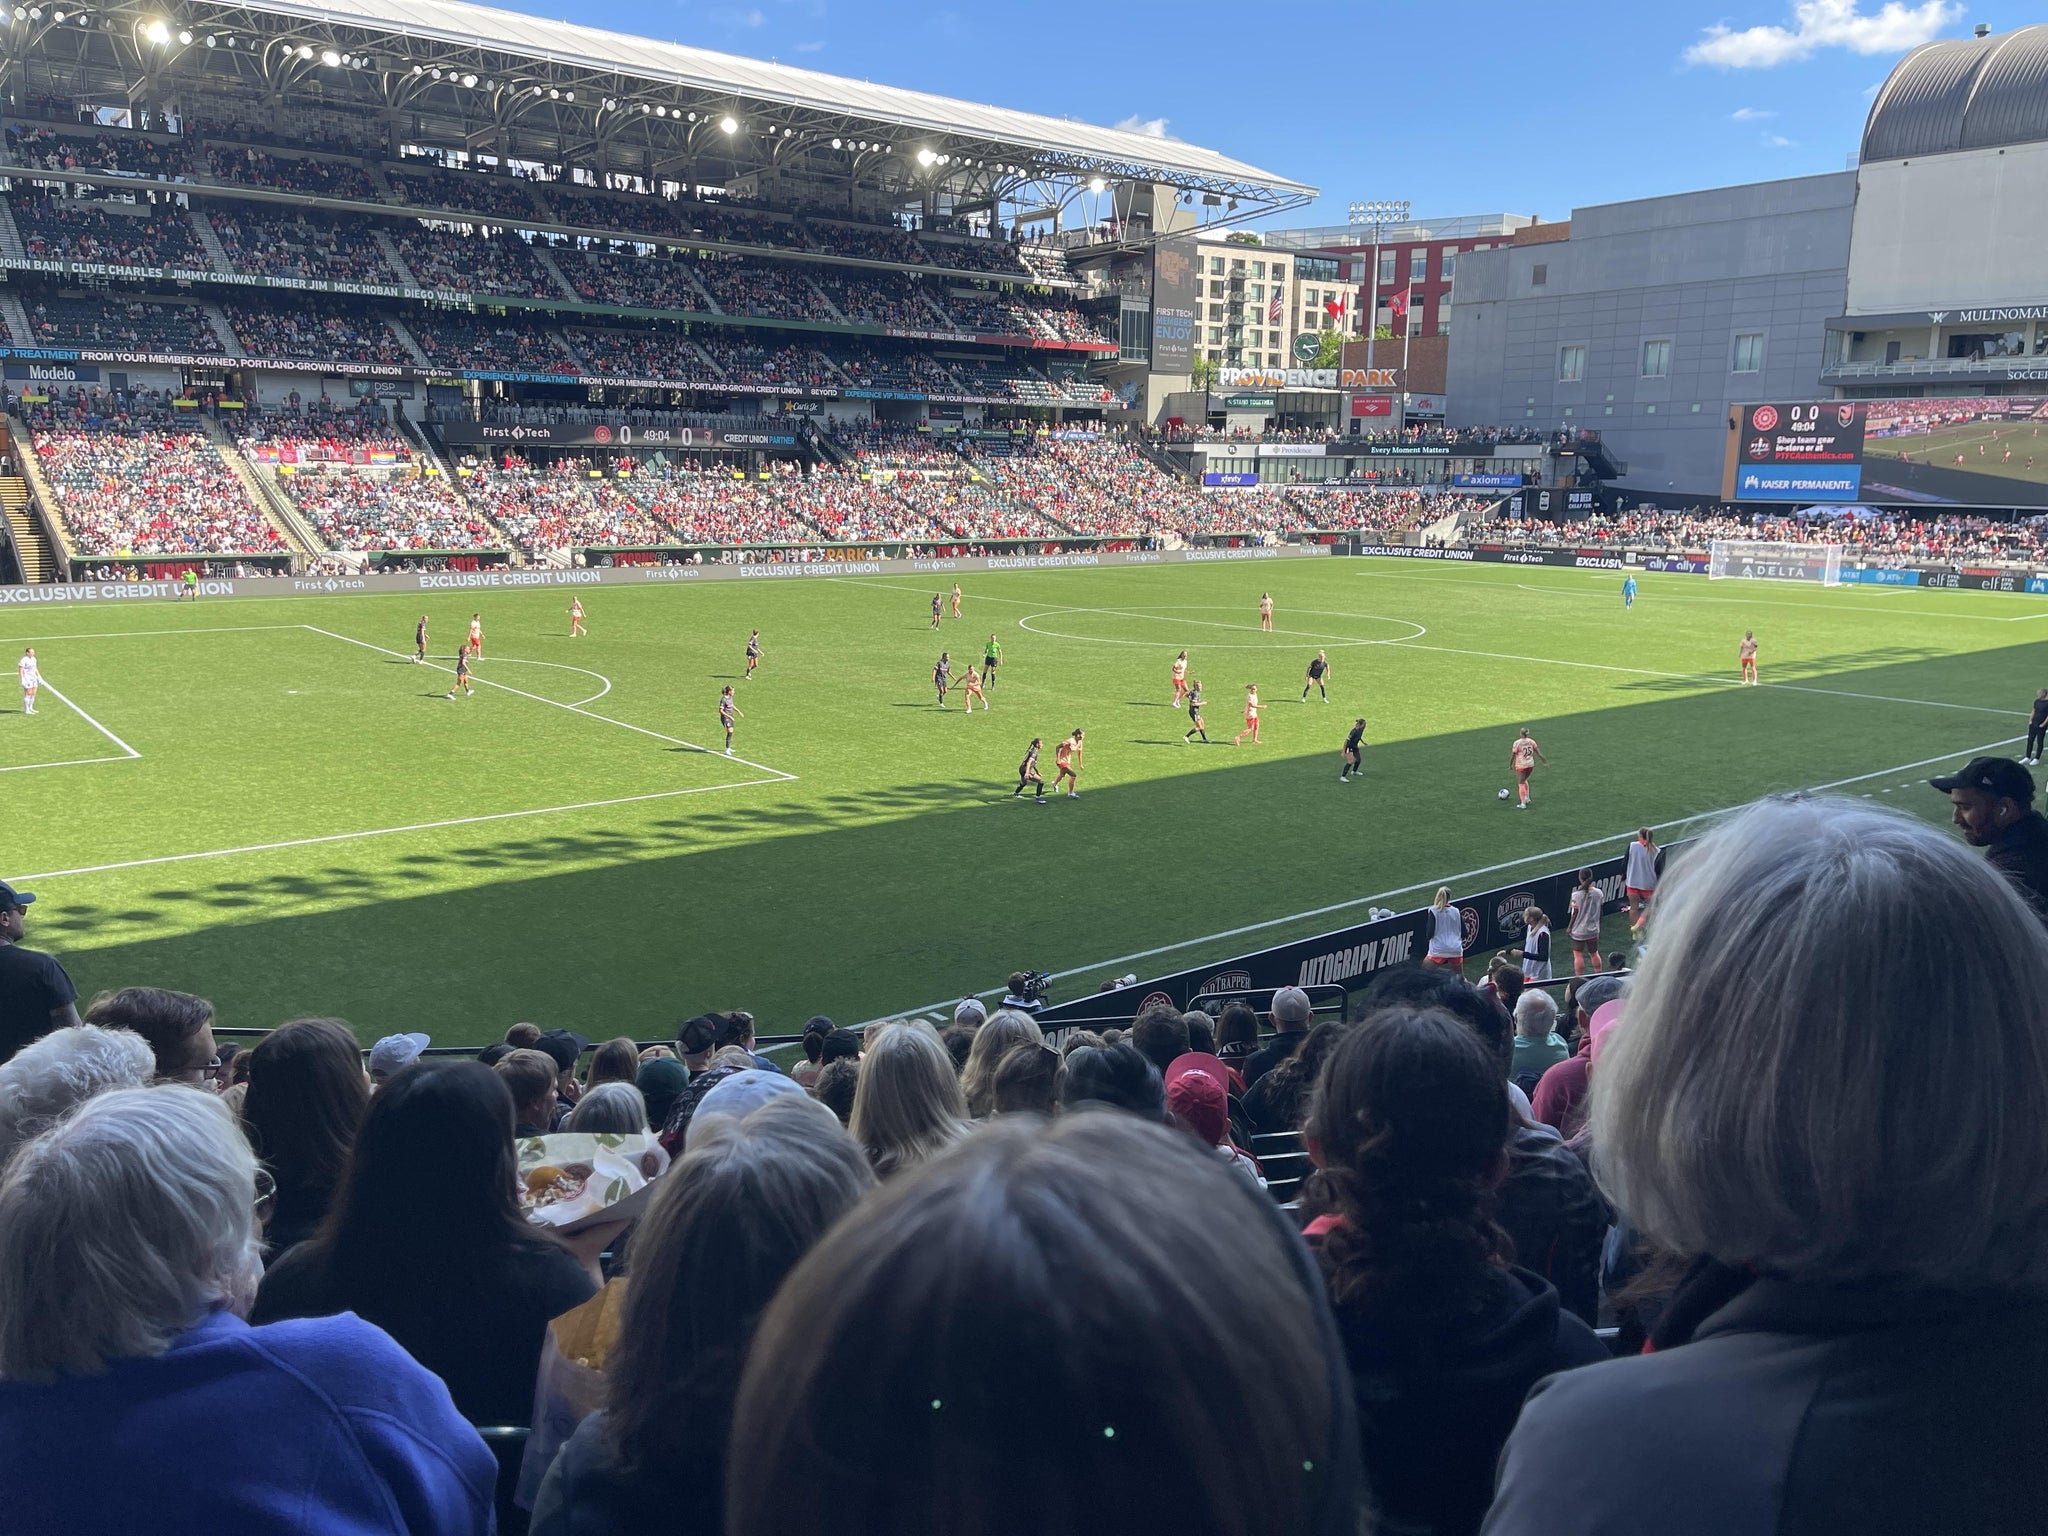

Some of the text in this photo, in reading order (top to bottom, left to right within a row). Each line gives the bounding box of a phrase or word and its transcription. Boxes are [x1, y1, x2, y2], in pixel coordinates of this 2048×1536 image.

[0, 258, 64, 272] JOHN BAIN
[71, 262, 163, 278] CLIVE CHARLES
[171, 269, 257, 285] JIMMY CONWAY
[265, 276, 328, 291] TIMBER JIM
[334, 282, 398, 297] MICK HOBAN
[404, 289, 472, 303] DIEGO VALERI
[1156, 307, 1193, 318] FIRST TECH
[1156, 316, 1193, 328] MEMBERS
[1155, 326, 1192, 340] ENJOY
[12, 348, 79, 360] TREATMENT
[81, 351, 114, 362] FROM
[115, 352, 147, 363] YOUR
[149, 354, 240, 368] MEMBER-OWNED,
[240, 358, 335, 372] PORTLAND-GROWN
[336, 363, 370, 374] CREDIT
[372, 365, 402, 376] UNION
[28, 364, 76, 380] Modelo
[413, 368, 452, 378] First Tech
[1218, 367, 1398, 388] PROVIDENCE PARK
[374, 382, 396, 391] DSP
[463, 371, 802, 396] EXPERIENCE VIP TREATMENT FROM YOUR MEMBER-OWNED, PORTLAND-GROWN CREDIT UNION
[844, 390, 882, 399] EXPERIENCE
[882, 392, 893, 400] VIP
[894, 392, 928, 401] TREATMENT
[928, 394, 946, 402] FROM
[1791, 406, 1800, 420] 0
[1809, 406, 1818, 420] 0
[484, 427, 550, 438] First Tech
[1791, 422, 1816, 432] 49:04
[620, 425, 692, 446] 0 49:04 0
[724, 434, 795, 446] CREDIT UNION PARTNER
[1776, 436, 1795, 445] Shop
[1797, 436, 1816, 444] team
[1817, 437, 1835, 446] gear
[1282, 446, 1312, 454] Providence
[1371, 446, 1450, 456] Every Moment Matters
[1776, 444, 1804, 452] in-store
[1814, 444, 1824, 452] at
[1775, 452, 1854, 460] PTFCAuthentics.com
[1220, 475, 1242, 484] xfinity
[1324, 477, 1341, 486] Ford
[1470, 476, 1500, 485] axiom
[1761, 480, 1790, 490] KAISER
[1569, 493, 1592, 502] PUB BEER
[826, 548, 868, 562] PARK
[1186, 548, 1278, 560] EXCLUSIVE CREDIT UNION
[1362, 546, 1474, 560] EXCLUSIVE CREDIT UNION
[1504, 554, 1519, 562] First
[914, 562, 931, 570] First
[988, 555, 1099, 568] EXCLUSIVE CREDIT UNION
[1576, 556, 1624, 568] EXCLUSIV
[1650, 560, 1668, 572] ally
[1676, 562, 1696, 572] ally
[646, 569, 698, 578] First Tech
[740, 562, 880, 578] EXCLUSIVE CREDIT UNION
[1756, 566, 1805, 578] DELTA
[294, 579, 364, 590] First Tech
[419, 570, 600, 588] EXCLUSIVE CREDIT UNION
[1928, 573, 1946, 586] elf
[1982, 576, 2000, 590] elf
[101, 583, 169, 599] CREDIT
[174, 581, 234, 597] UION
[1522, 746, 1533, 758] 25
[1298, 930, 1414, 987] AUTOGRAPH ZONE
[1215, 976, 1250, 992] TRAPPER
